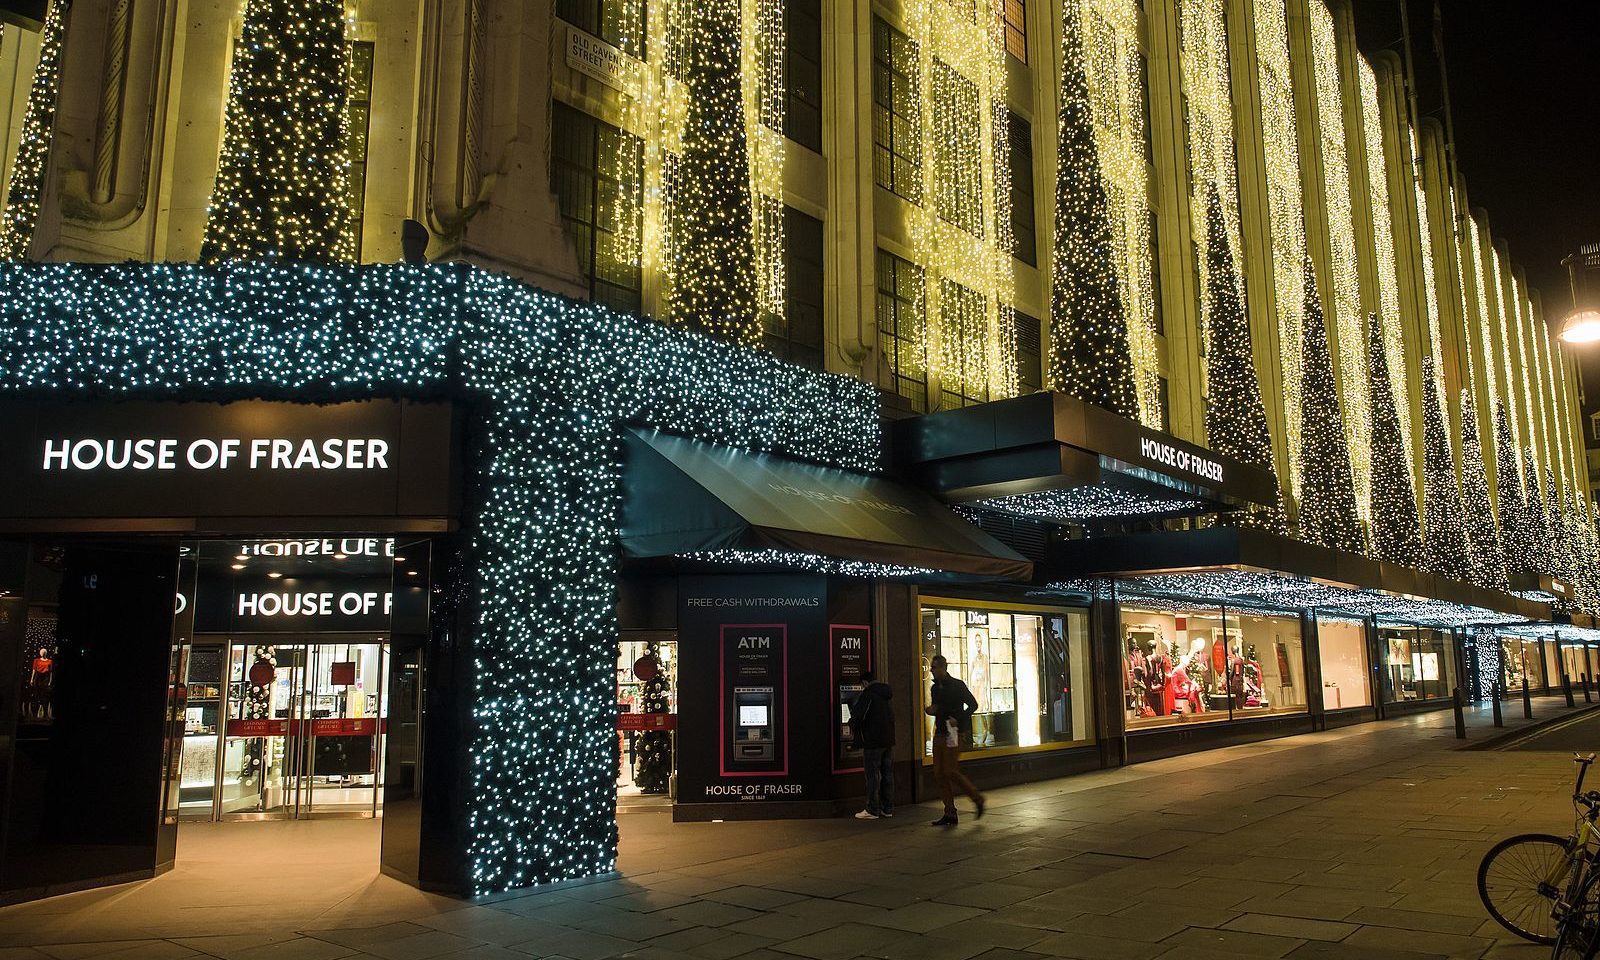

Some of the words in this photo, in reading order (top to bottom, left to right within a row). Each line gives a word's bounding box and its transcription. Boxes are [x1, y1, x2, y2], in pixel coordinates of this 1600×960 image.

[572, 33, 589, 49] OLD
[572, 45, 602, 68] STREET
[607, 62, 619, 76] W1
[43, 439, 178, 471] HOUSE
[186, 439, 241, 471] OF
[249, 438, 390, 470] FRASER
[1141, 436, 1177, 467] HOUSE
[1176, 450, 1190, 471] OF
[1191, 455, 1223, 482] FRASER
[238, 592, 334, 616] HOUSE
[339, 592, 378, 615] OF
[687, 598, 712, 607] FREE
[714, 598, 742, 607] CASH
[744, 598, 819, 607] WITHDRAWALS
[967, 611, 988, 625] Dior
[738, 636, 770, 649] ATM
[840, 637, 861, 650] ATM
[705, 785, 743, 795] HOUSE
[745, 785, 761, 795] OF
[763, 784, 802, 794] FRASER
